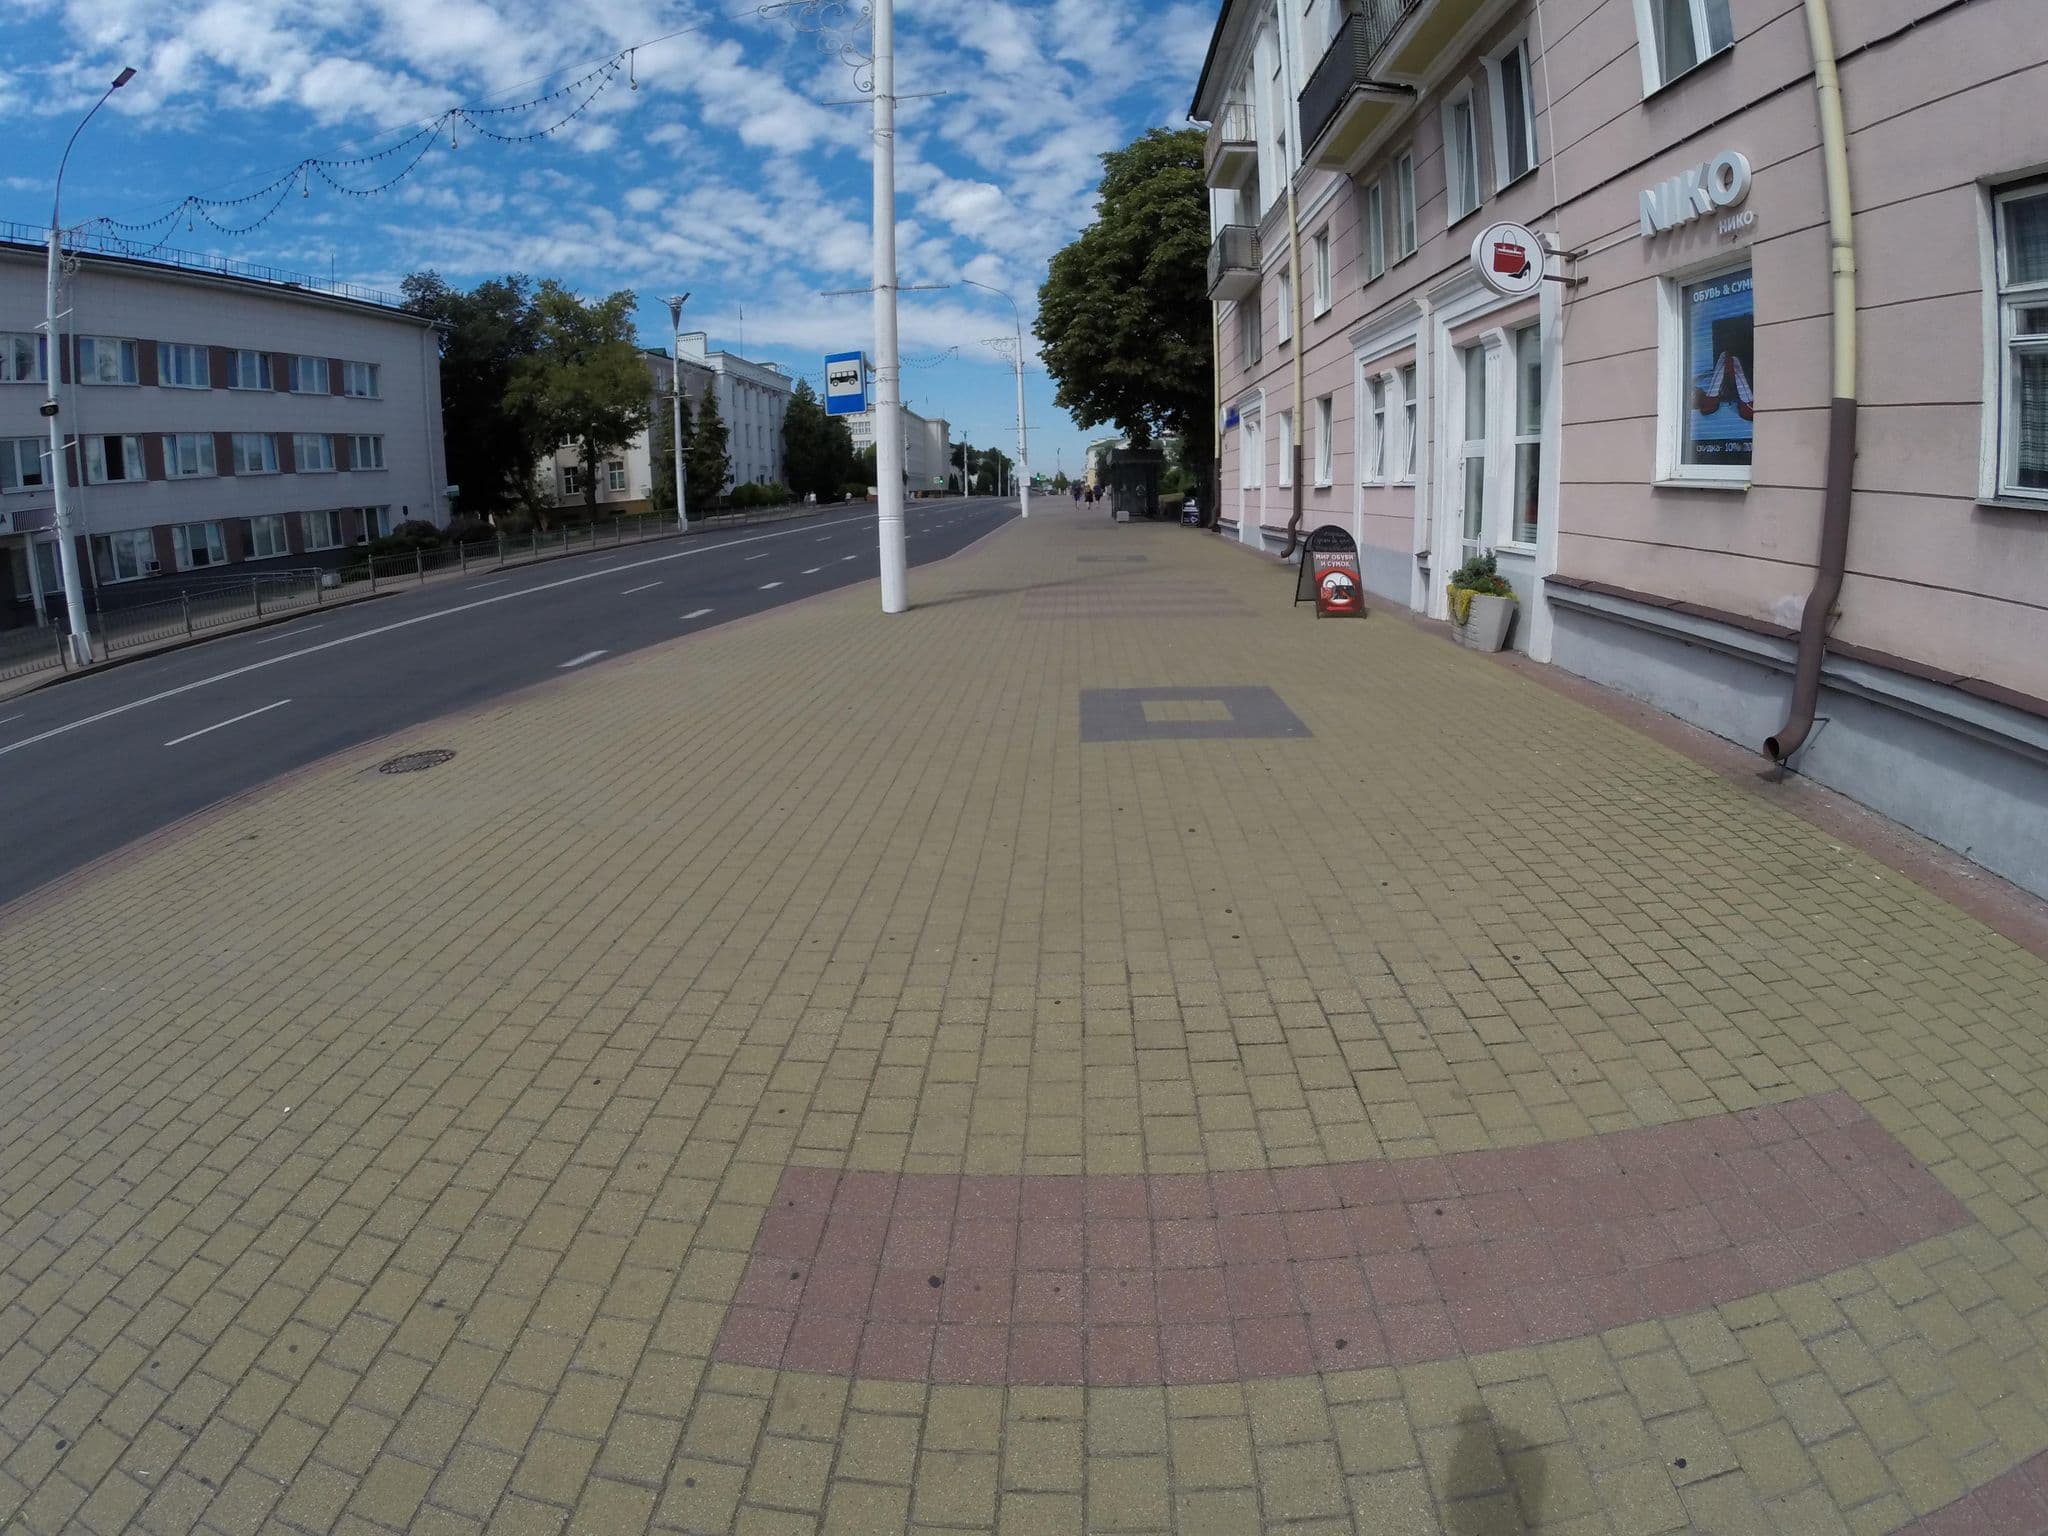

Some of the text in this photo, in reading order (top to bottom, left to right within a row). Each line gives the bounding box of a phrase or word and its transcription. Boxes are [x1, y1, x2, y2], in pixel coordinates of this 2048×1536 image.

[1639, 149, 1752, 239] NIKO
[1719, 210, 1754, 234] НИКО
[1693, 286, 1721, 302] ОБУВЬ
